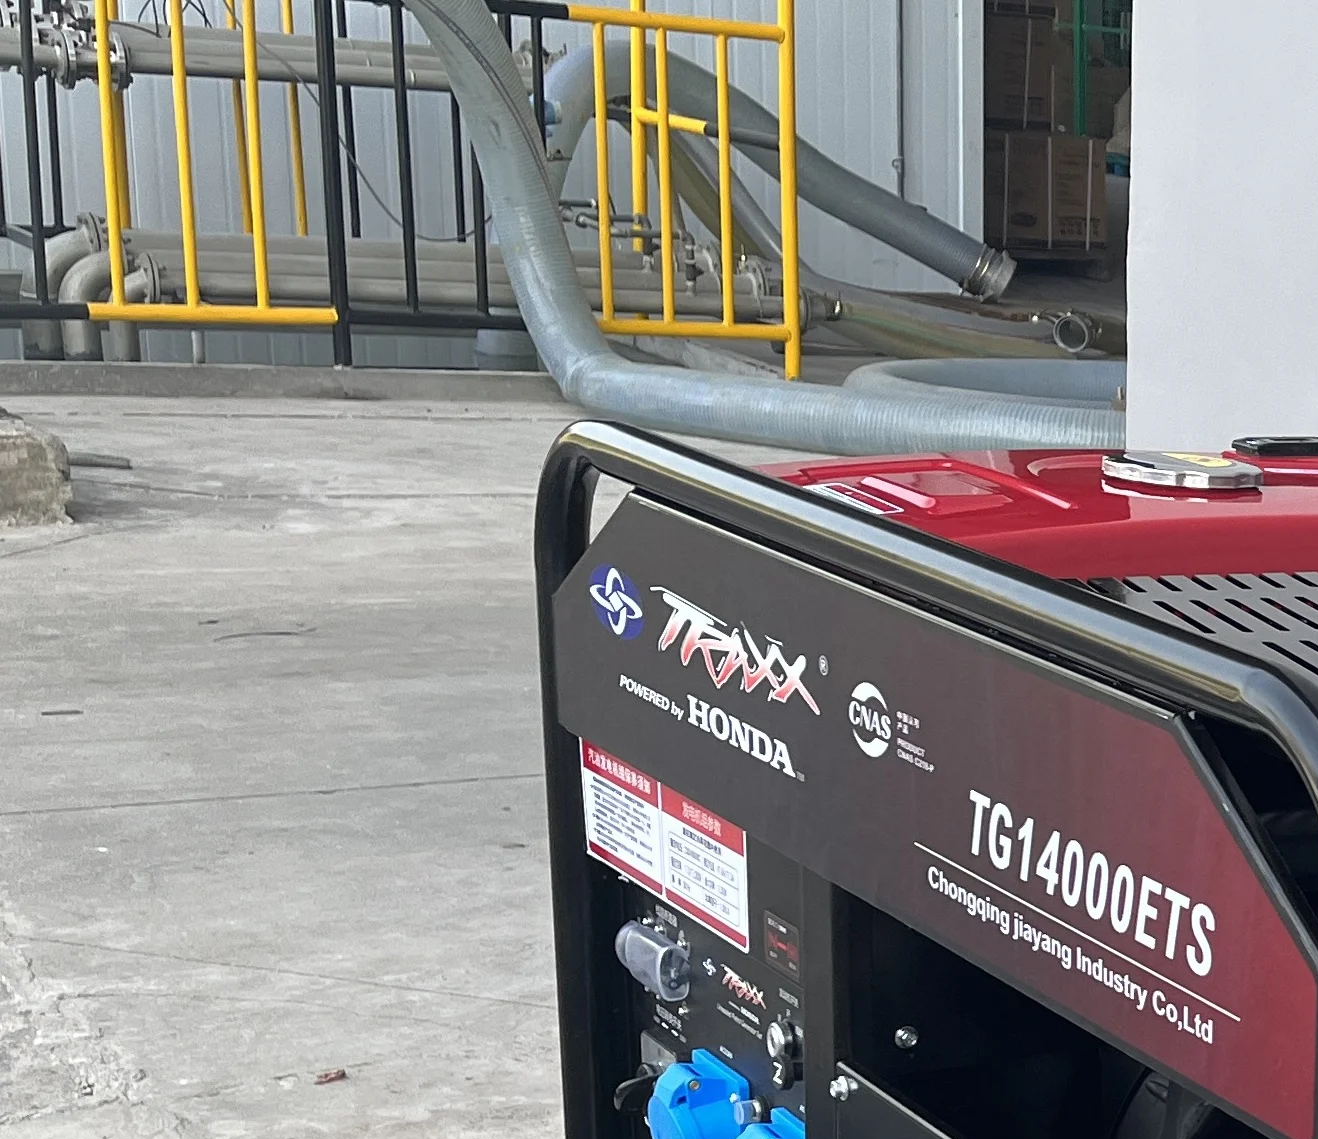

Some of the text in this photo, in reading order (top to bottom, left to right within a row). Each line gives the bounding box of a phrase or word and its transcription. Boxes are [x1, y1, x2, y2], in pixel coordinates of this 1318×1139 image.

[649, 586, 821, 716] TRAXX
[618, 674, 797, 778] POWERED by HONDA
[848, 700, 892, 740] CNAS
[969, 789, 1216, 976] TG14000ETS
[927, 865, 1214, 1045] Chongqing jiayang Industry Co,Ltd
